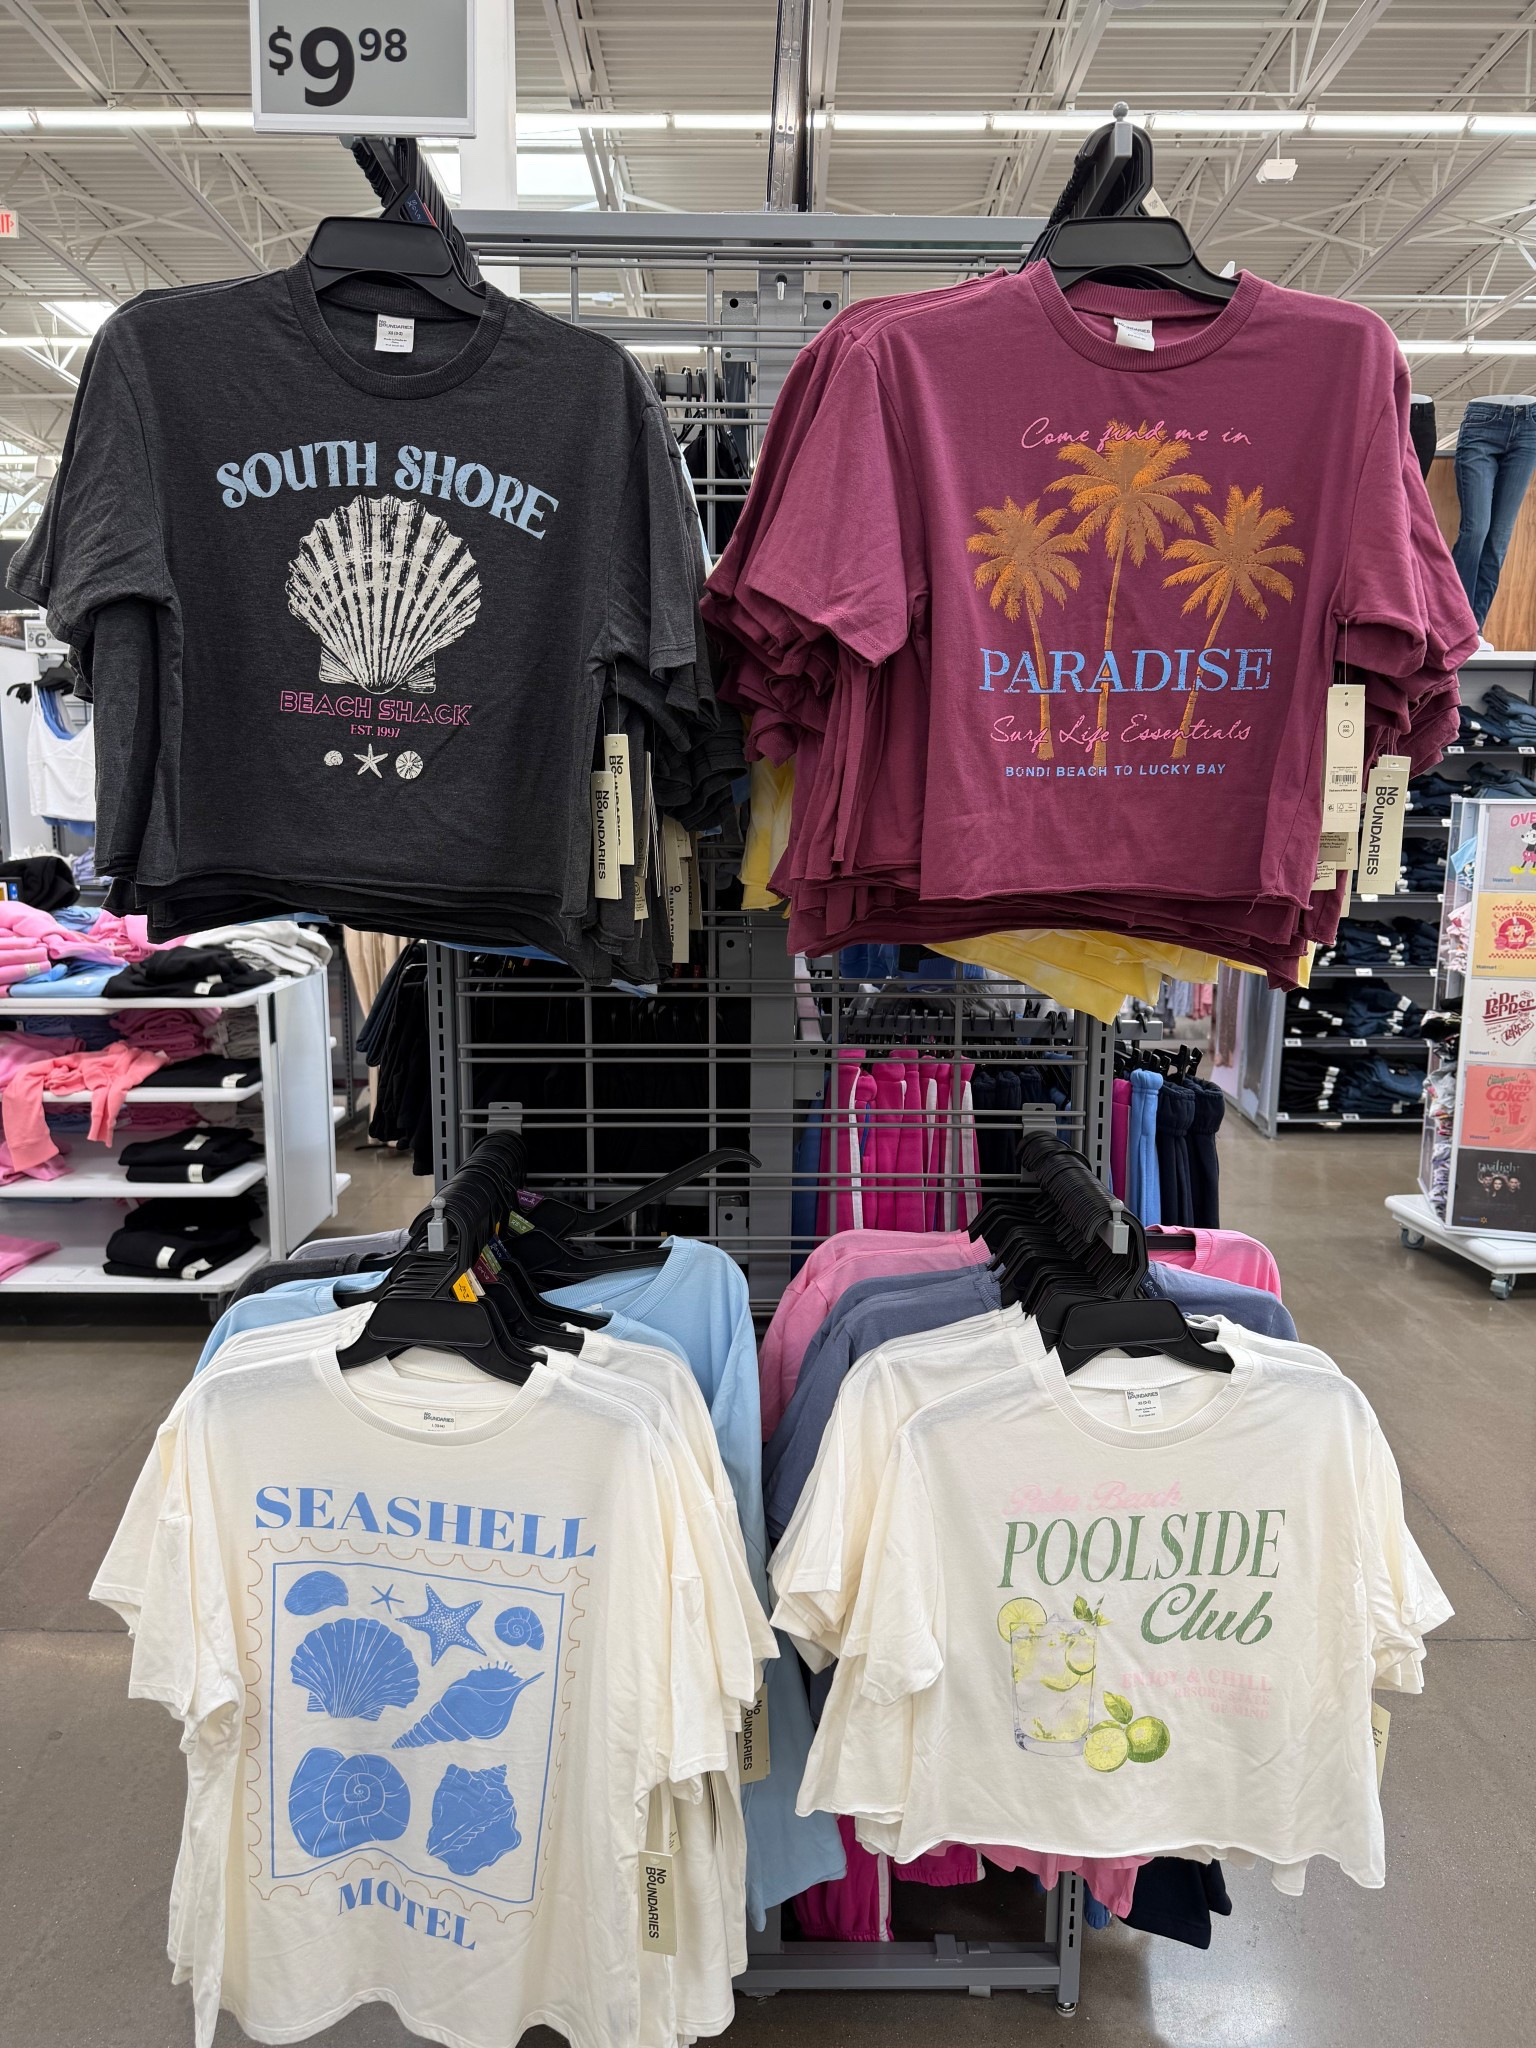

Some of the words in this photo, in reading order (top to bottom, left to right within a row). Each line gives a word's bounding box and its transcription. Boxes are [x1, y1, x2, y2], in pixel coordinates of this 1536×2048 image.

[0, 213, 11, 233] IT
[1021, 417, 1091, 449] Come
[1096, 420, 1165, 452] find
[1174, 428, 1208, 442] me
[1222, 427, 1252, 445] in
[216, 440, 378, 509] SOUTH
[394, 445, 560, 541] SHORE
[979, 647, 1273, 694] PARADISE
[280, 690, 372, 719] BEACH
[378, 699, 473, 726] SHACK
[350, 723, 374, 737] EST.
[376, 725, 401, 738] 1997
[990, 715, 1049, 753] Surf
[1059, 714, 1110, 753] Life
[1120, 713, 1252, 743] Essentials
[1005, 766, 1051, 778] BONDI
[1056, 765, 1108, 778] BEACH
[1114, 764, 1133, 776] TO
[1139, 763, 1191, 776] LUCKY
[1196, 763, 1227, 775] BAY
[595, 790, 606, 880] BOUNDARIES
[1366, 786, 1387, 876] BOUNDARIES
[1484, 998, 1535, 1017] Pepper
[1499, 992, 1519, 1005] Dr
[1486, 1085, 1527, 1102] Coke
[1087, 1480, 1184, 1511] Beach
[255, 1486, 597, 1560] SEASHELL
[997, 1509, 1287, 1588] POOLSIDE
[1140, 1582, 1274, 1646] Club
[1121, 1670, 1178, 1689] ENJOY
[1186, 1665, 1201, 1684] &
[1207, 1667, 1272, 1691] CHILL
[1174, 1687, 1225, 1699] RESORT
[1228, 1690, 1270, 1706] STATE
[1210, 1702, 1226, 1714] OF
[1232, 1705, 1270, 1720] MIND
[743, 1708, 754, 1771] OUNDARIES
[337, 1877, 477, 1951] MOTEL
[645, 1866, 659, 1939] BOUNDARIES
